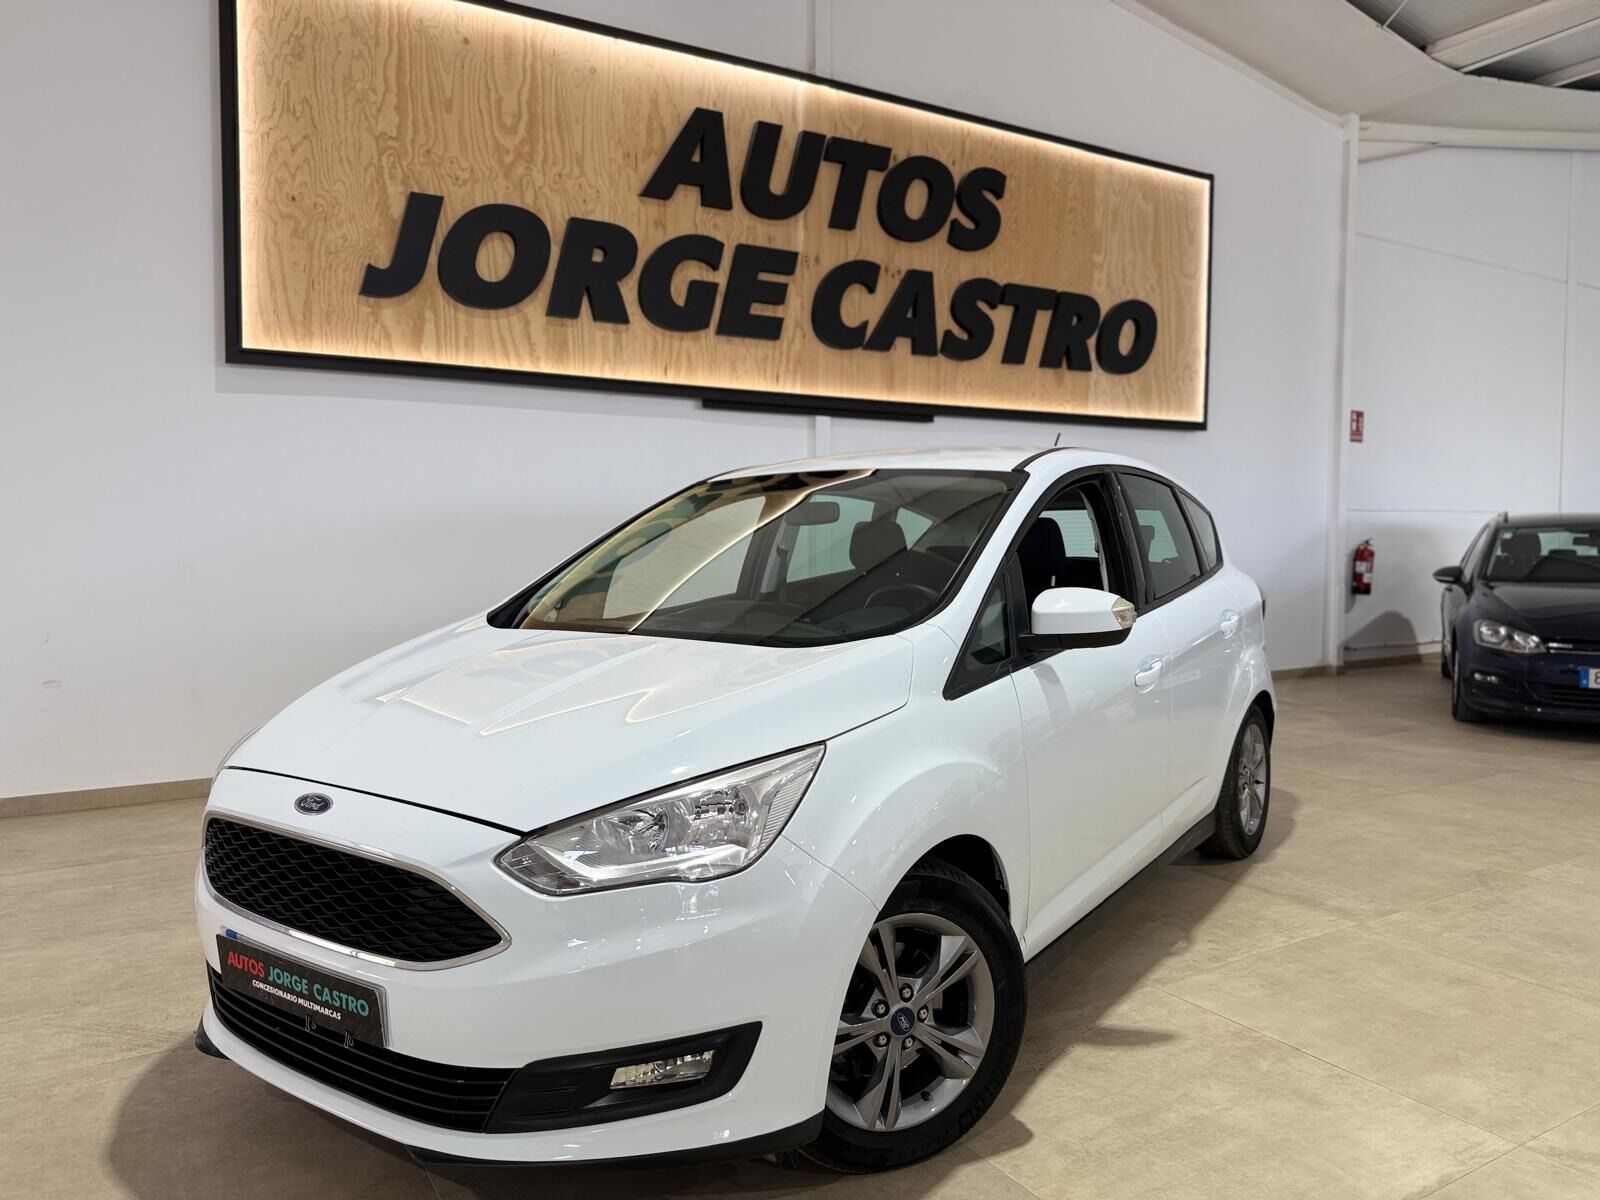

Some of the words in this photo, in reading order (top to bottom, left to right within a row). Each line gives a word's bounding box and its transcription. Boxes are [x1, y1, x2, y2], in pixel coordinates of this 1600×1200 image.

[640, 106, 1006, 251] AUTOS
[359, 191, 799, 341] JORGE
[811, 260, 1157, 375] CASTRO
[300, 796, 325, 811] Ford
[227, 951, 265, 977] AUTOS
[268, 966, 309, 995] JORGE
[313, 983, 369, 1017] CASTRO
[252, 979, 298, 1003] CONCESIONARIO
[297, 998, 342, 1020] MULTIMARCAS
